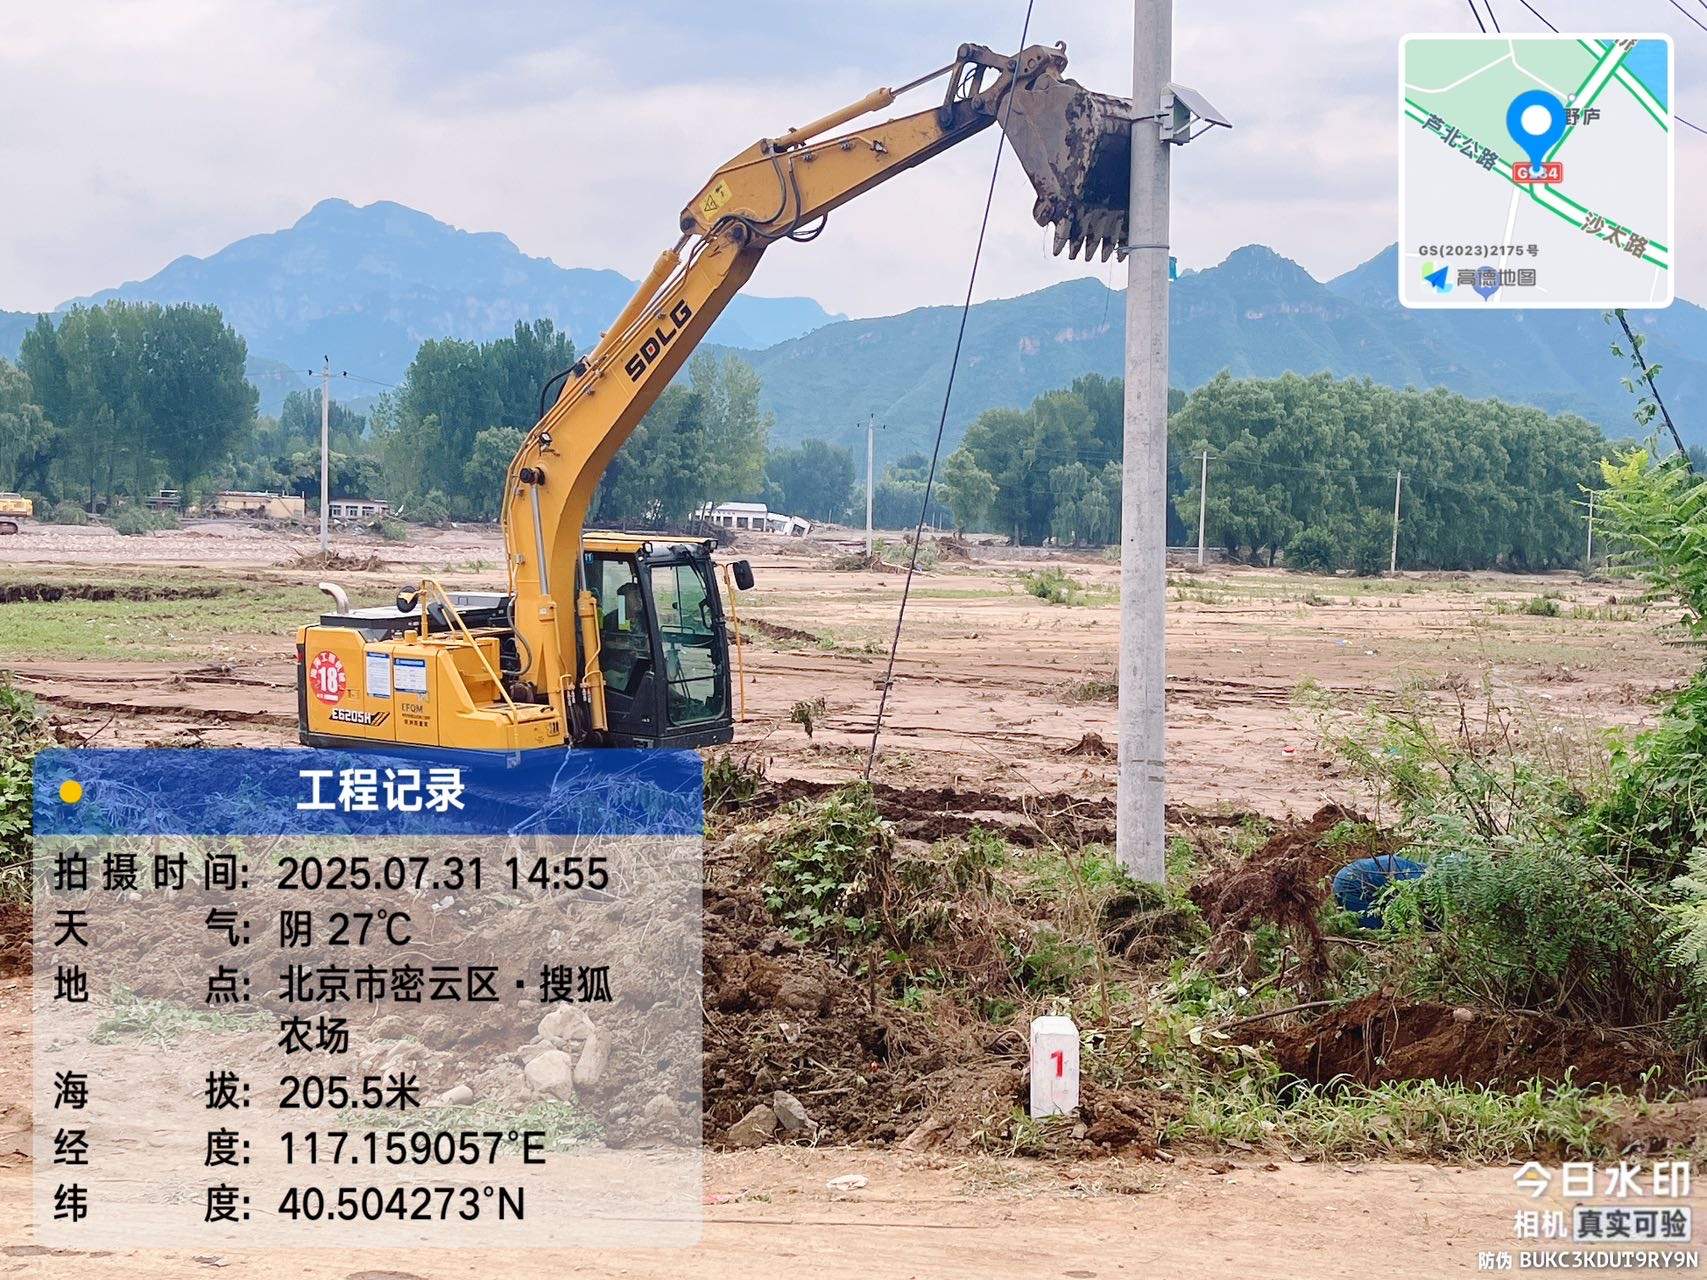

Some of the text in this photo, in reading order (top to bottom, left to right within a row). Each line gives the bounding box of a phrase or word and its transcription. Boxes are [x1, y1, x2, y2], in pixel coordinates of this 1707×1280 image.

[624, 298, 692, 382] SDLG
[318, 667, 338, 693] 18
[1050, 1050, 1063, 1077] 1
